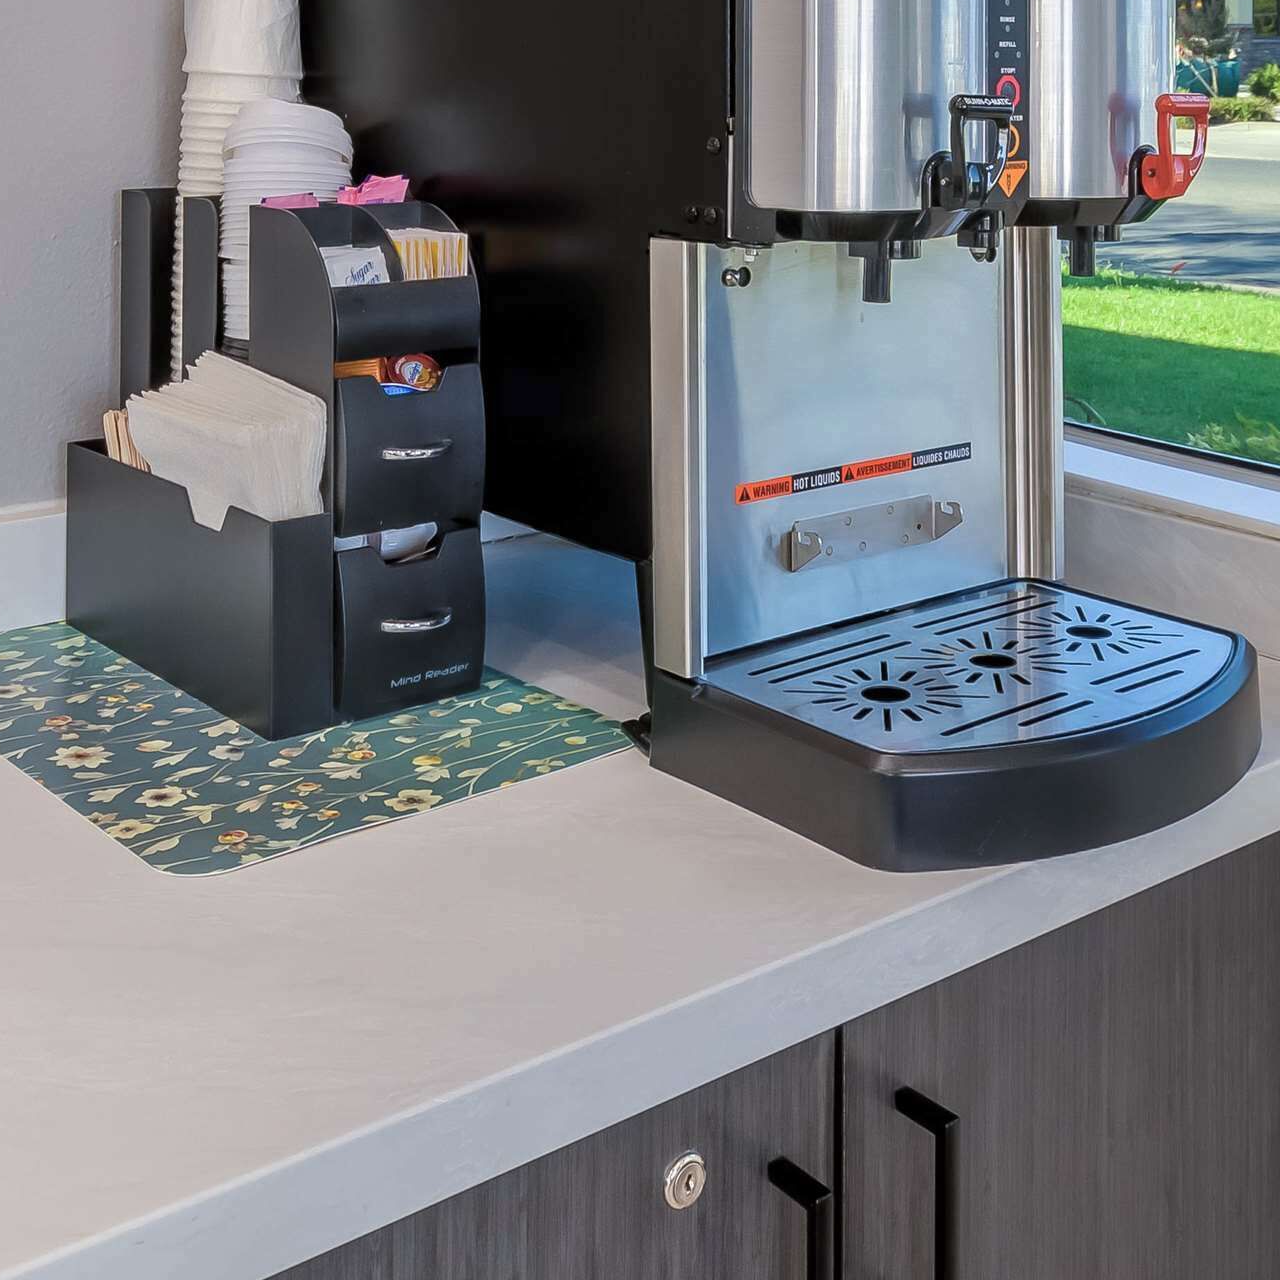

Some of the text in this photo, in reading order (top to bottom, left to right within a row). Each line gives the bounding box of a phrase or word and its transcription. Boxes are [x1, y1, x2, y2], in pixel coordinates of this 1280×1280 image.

[999, 15, 1016, 23] RINSE
[998, 40, 1017, 48] REFILL
[752, 446, 970, 499] WARNING HOT LIQUIDS AVERTISSEMENT LIQUIDES CHAUDS
[390, 662, 469, 689] Mind Reader
